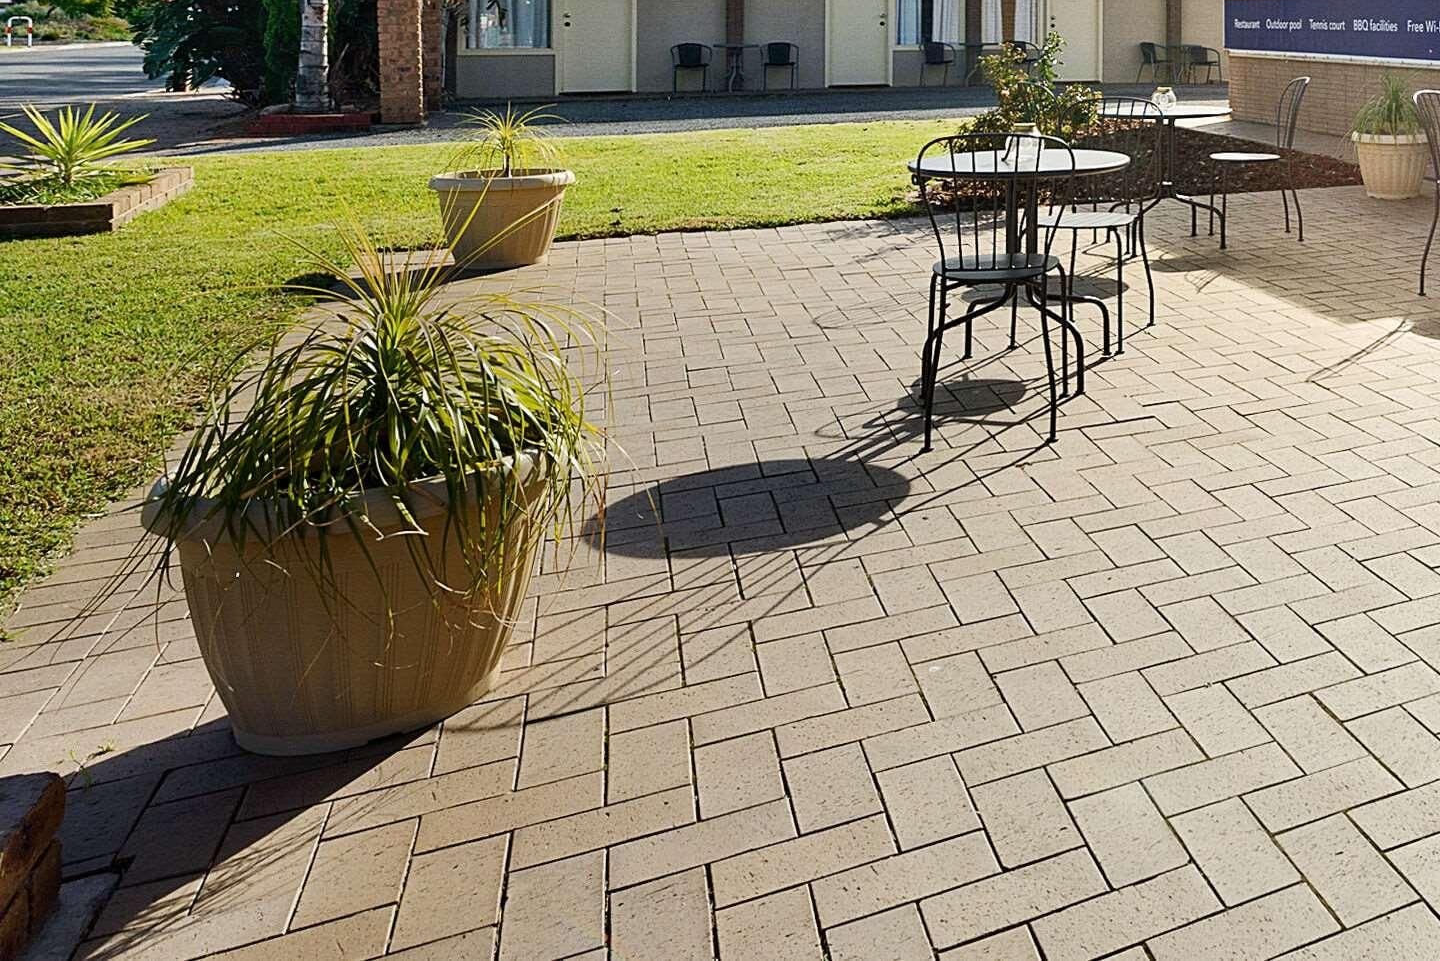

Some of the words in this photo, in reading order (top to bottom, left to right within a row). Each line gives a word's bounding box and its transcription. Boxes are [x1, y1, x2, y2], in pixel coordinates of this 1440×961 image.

[1234, 19, 1260, 29] Restaurant
[1265, 19, 1288, 30] Outdoor
[1289, 19, 1303, 32] pool
[1309, 19, 1328, 30] Tennis
[1329, 21, 1345, 31] court
[1353, 19, 1368, 31] BBQ
[1370, 19, 1398, 32] facilities
[1407, 20, 1424, 32] Free
